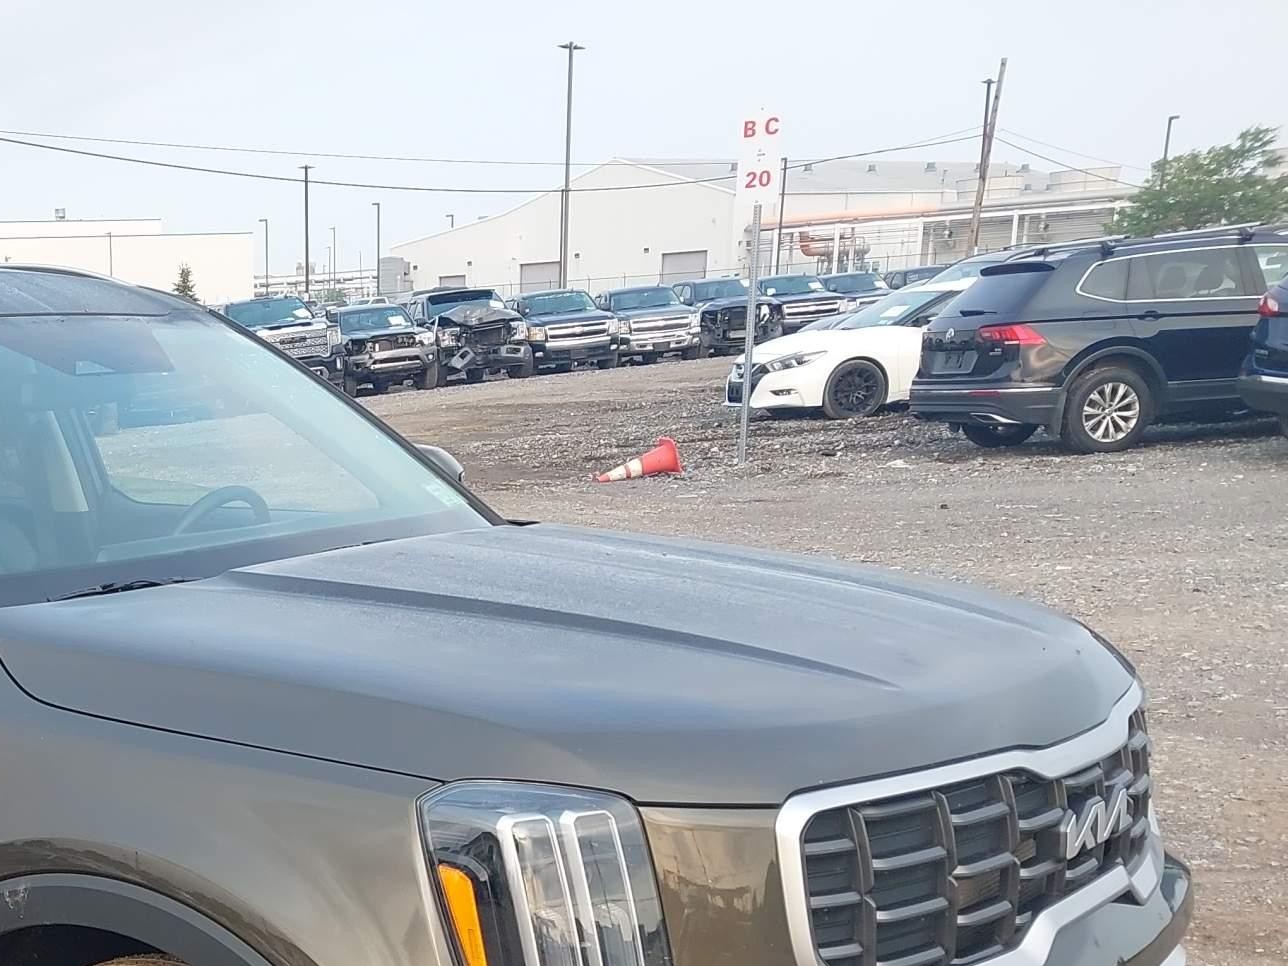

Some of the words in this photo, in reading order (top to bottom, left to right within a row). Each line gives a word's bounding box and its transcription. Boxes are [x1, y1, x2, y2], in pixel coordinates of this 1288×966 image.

[743, 120, 757, 138] B
[764, 117, 780, 135] C
[745, 170, 772, 188] 20
